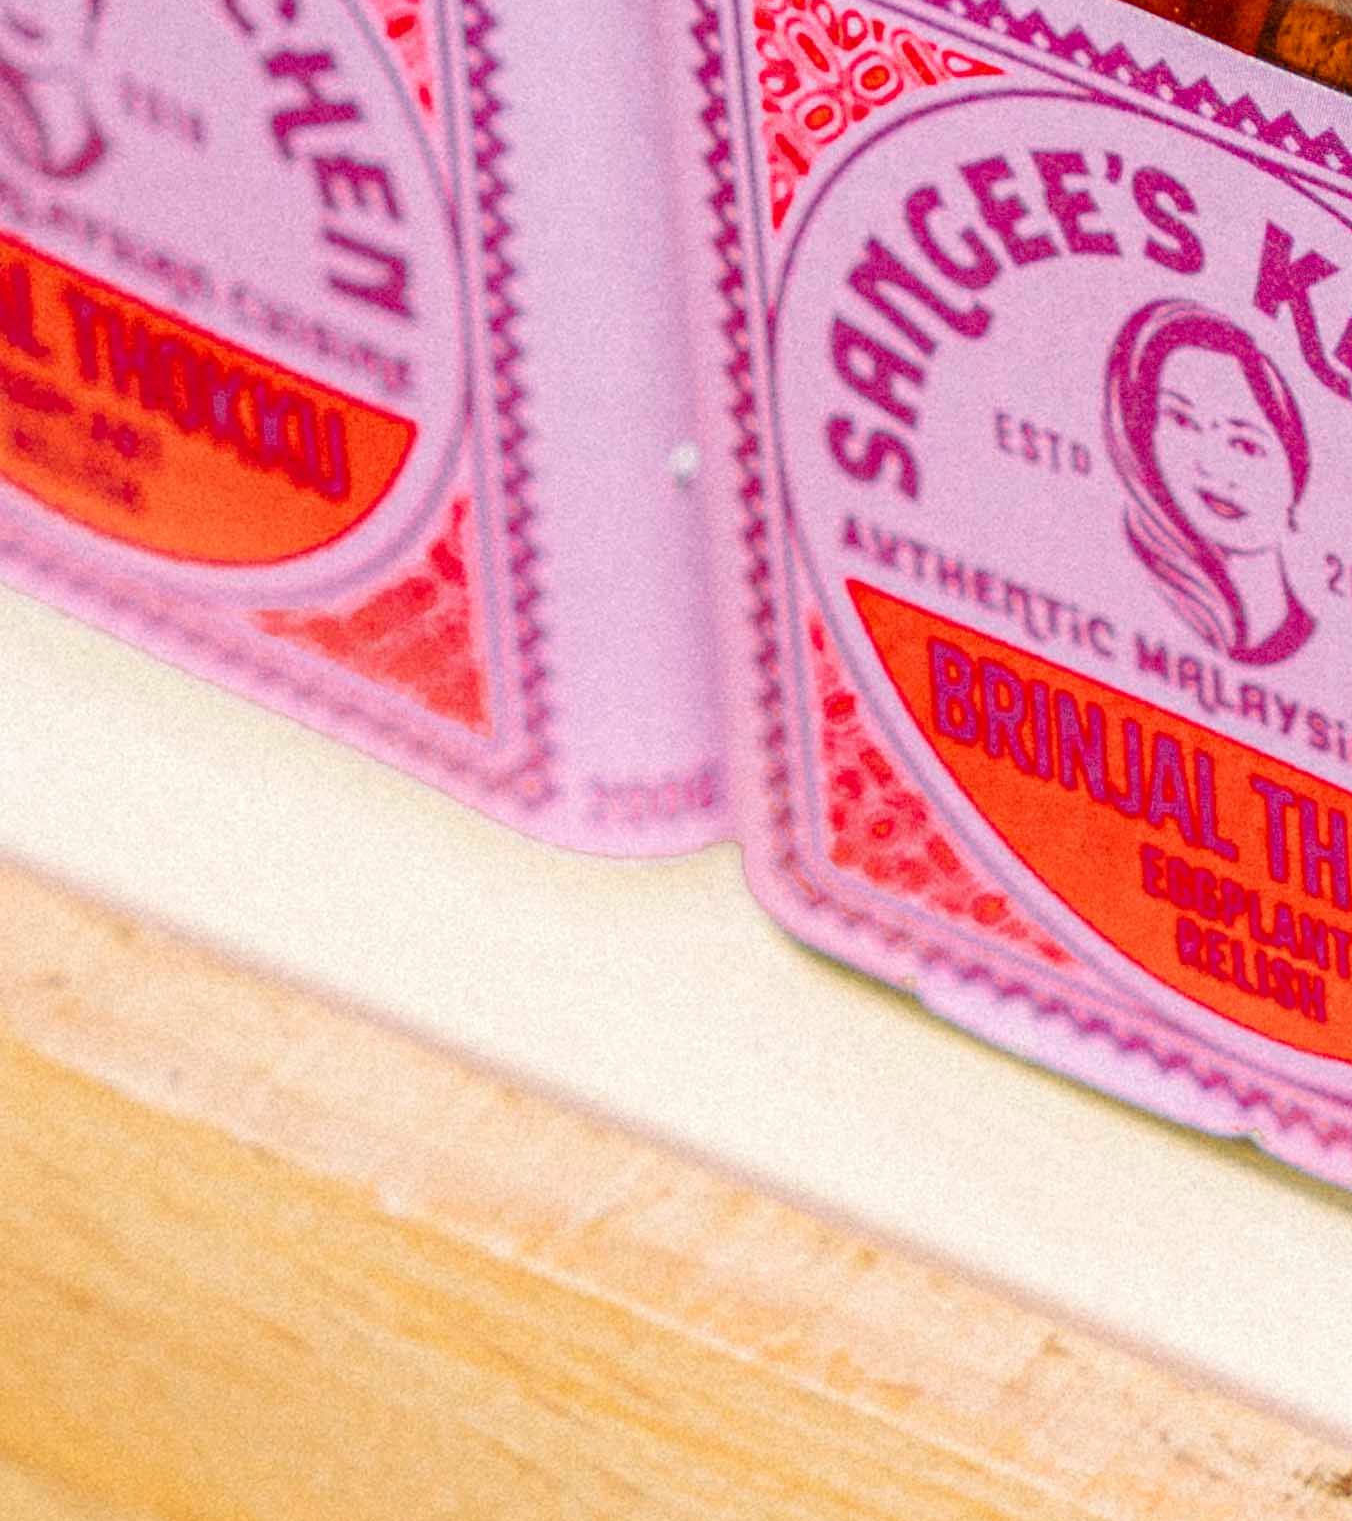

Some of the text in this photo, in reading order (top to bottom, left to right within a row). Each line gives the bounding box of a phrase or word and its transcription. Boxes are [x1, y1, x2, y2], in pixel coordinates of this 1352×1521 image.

[829, 151, 1208, 500] SANGEE'S
[995, 412, 1092, 477] ESTD
[927, 635, 1237, 860] BRINJAL
[1176, 918, 1328, 1024] RELISH
